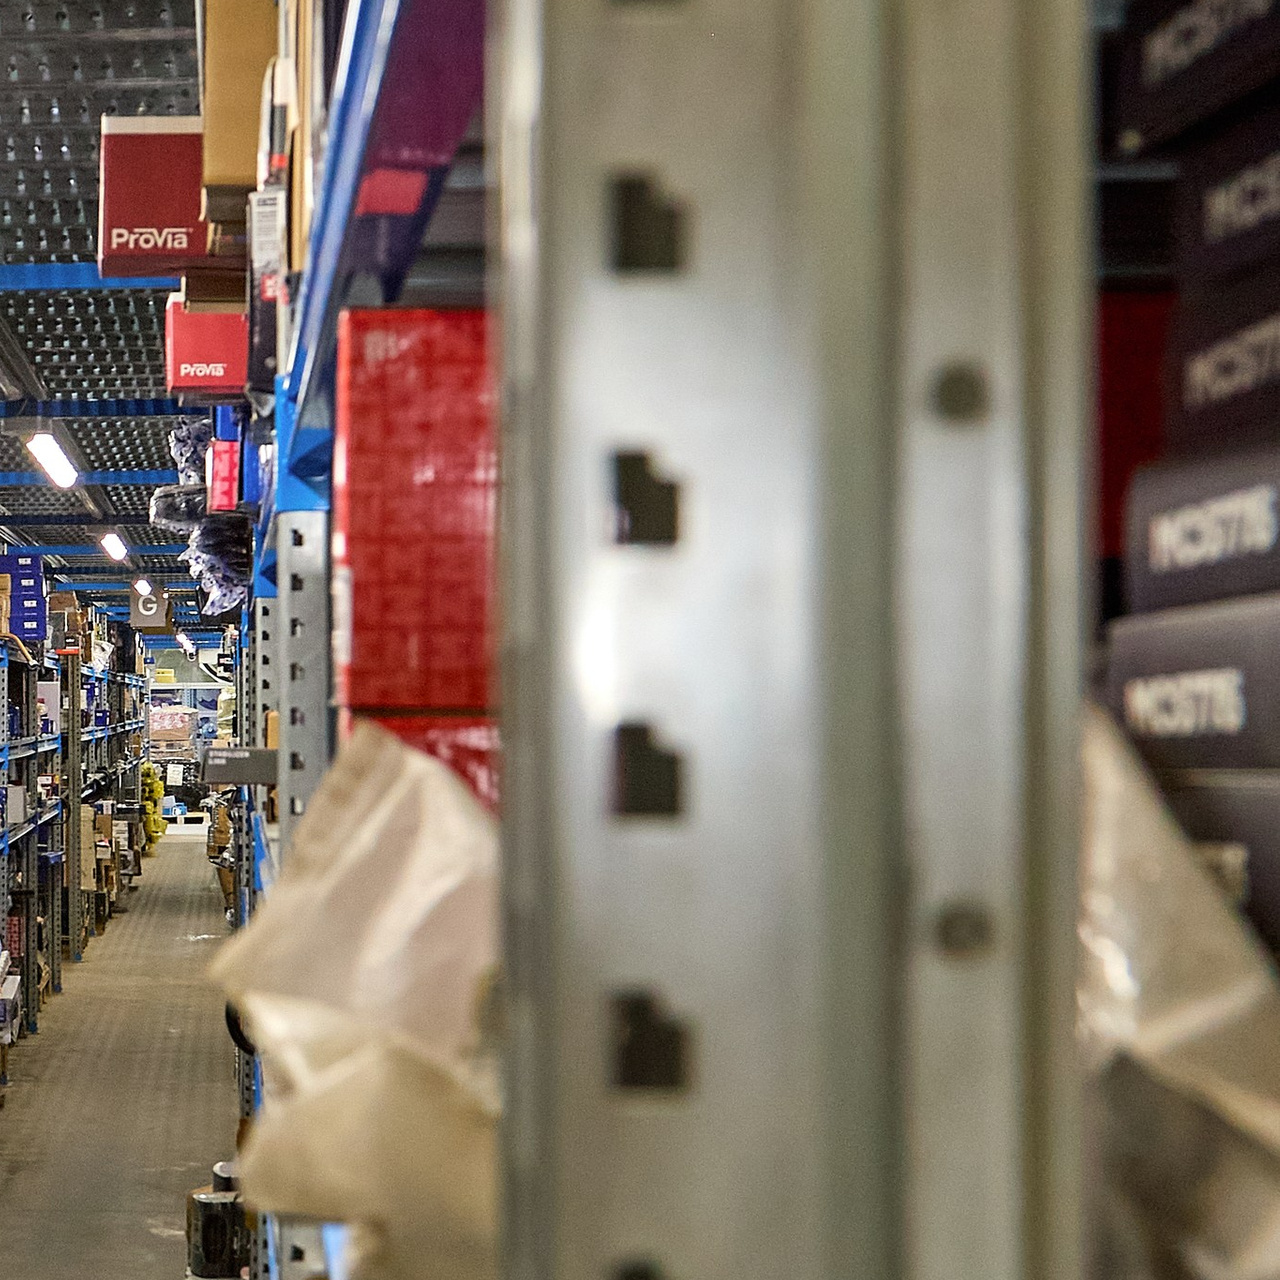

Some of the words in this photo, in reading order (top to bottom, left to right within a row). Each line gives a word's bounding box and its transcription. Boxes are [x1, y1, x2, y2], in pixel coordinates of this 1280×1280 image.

[110, 228, 189, 249] ProVia
[180, 363, 225, 377] ProVia
[138, 594, 158, 616] G
